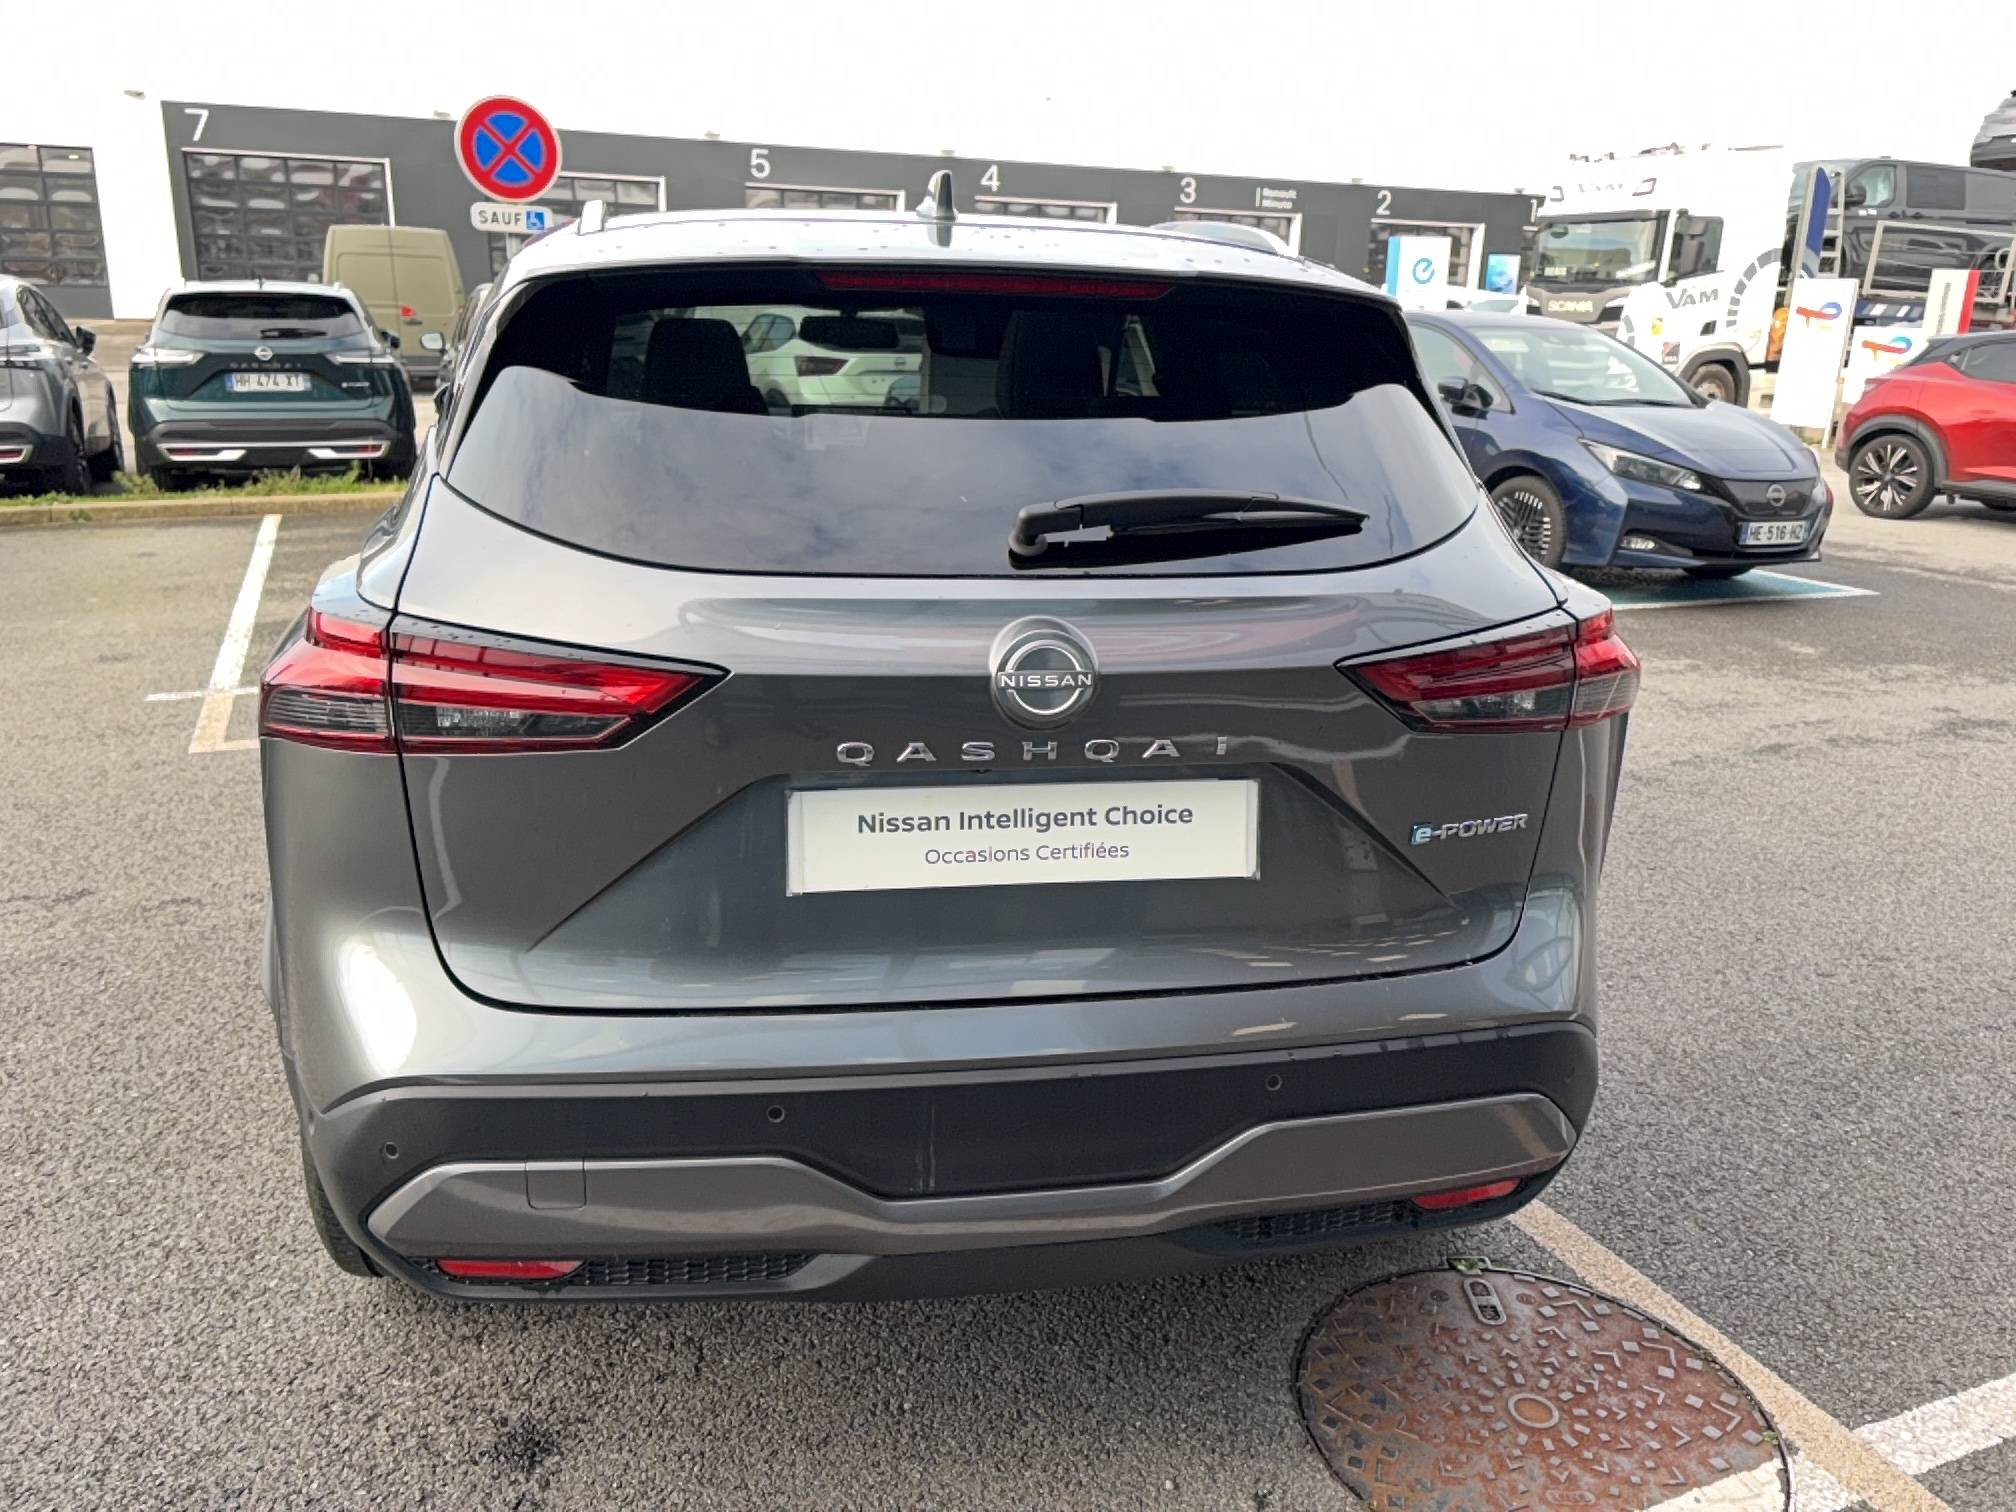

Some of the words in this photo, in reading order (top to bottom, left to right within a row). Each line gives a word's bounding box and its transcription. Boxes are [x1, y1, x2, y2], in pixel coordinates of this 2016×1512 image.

[184, 107, 209, 142] 7
[750, 148, 771, 179] 5
[980, 164, 1001, 192] 4
[1180, 176, 1197, 204] 3
[1375, 189, 1392, 215] 2
[478, 210, 522, 226] SAUF
[1000, 673, 1093, 688] NISSAN
[836, 736, 1229, 767] QASHQAI
[857, 811, 951, 834] Nissan
[959, 806, 1098, 833] Intelligent
[1104, 803, 1194, 826] Choice
[1410, 813, 1529, 845] e-POWER
[925, 846, 1031, 865] Occasions
[1036, 842, 1130, 861] Certifiées
